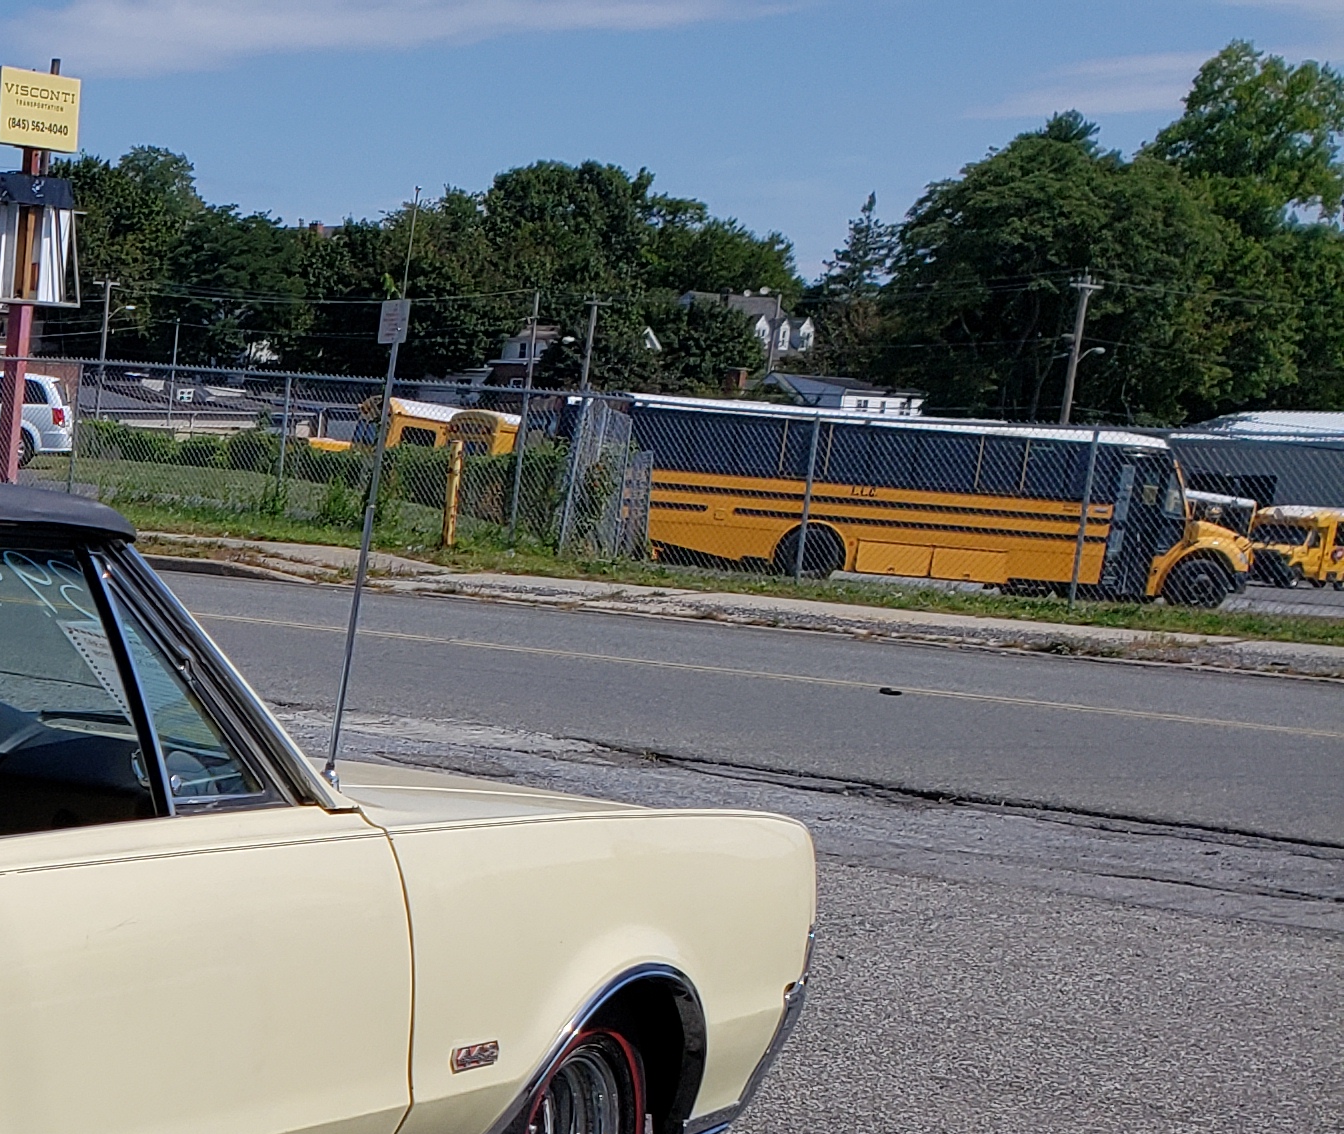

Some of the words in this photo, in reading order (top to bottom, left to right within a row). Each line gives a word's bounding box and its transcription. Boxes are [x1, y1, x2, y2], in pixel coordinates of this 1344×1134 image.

[4, 82, 76, 104] VISCONTI
[15, 98, 64, 113] TRANSPORTATION
[8, 117, 29, 132] (845)
[31, 120, 69, 136] 562-4040
